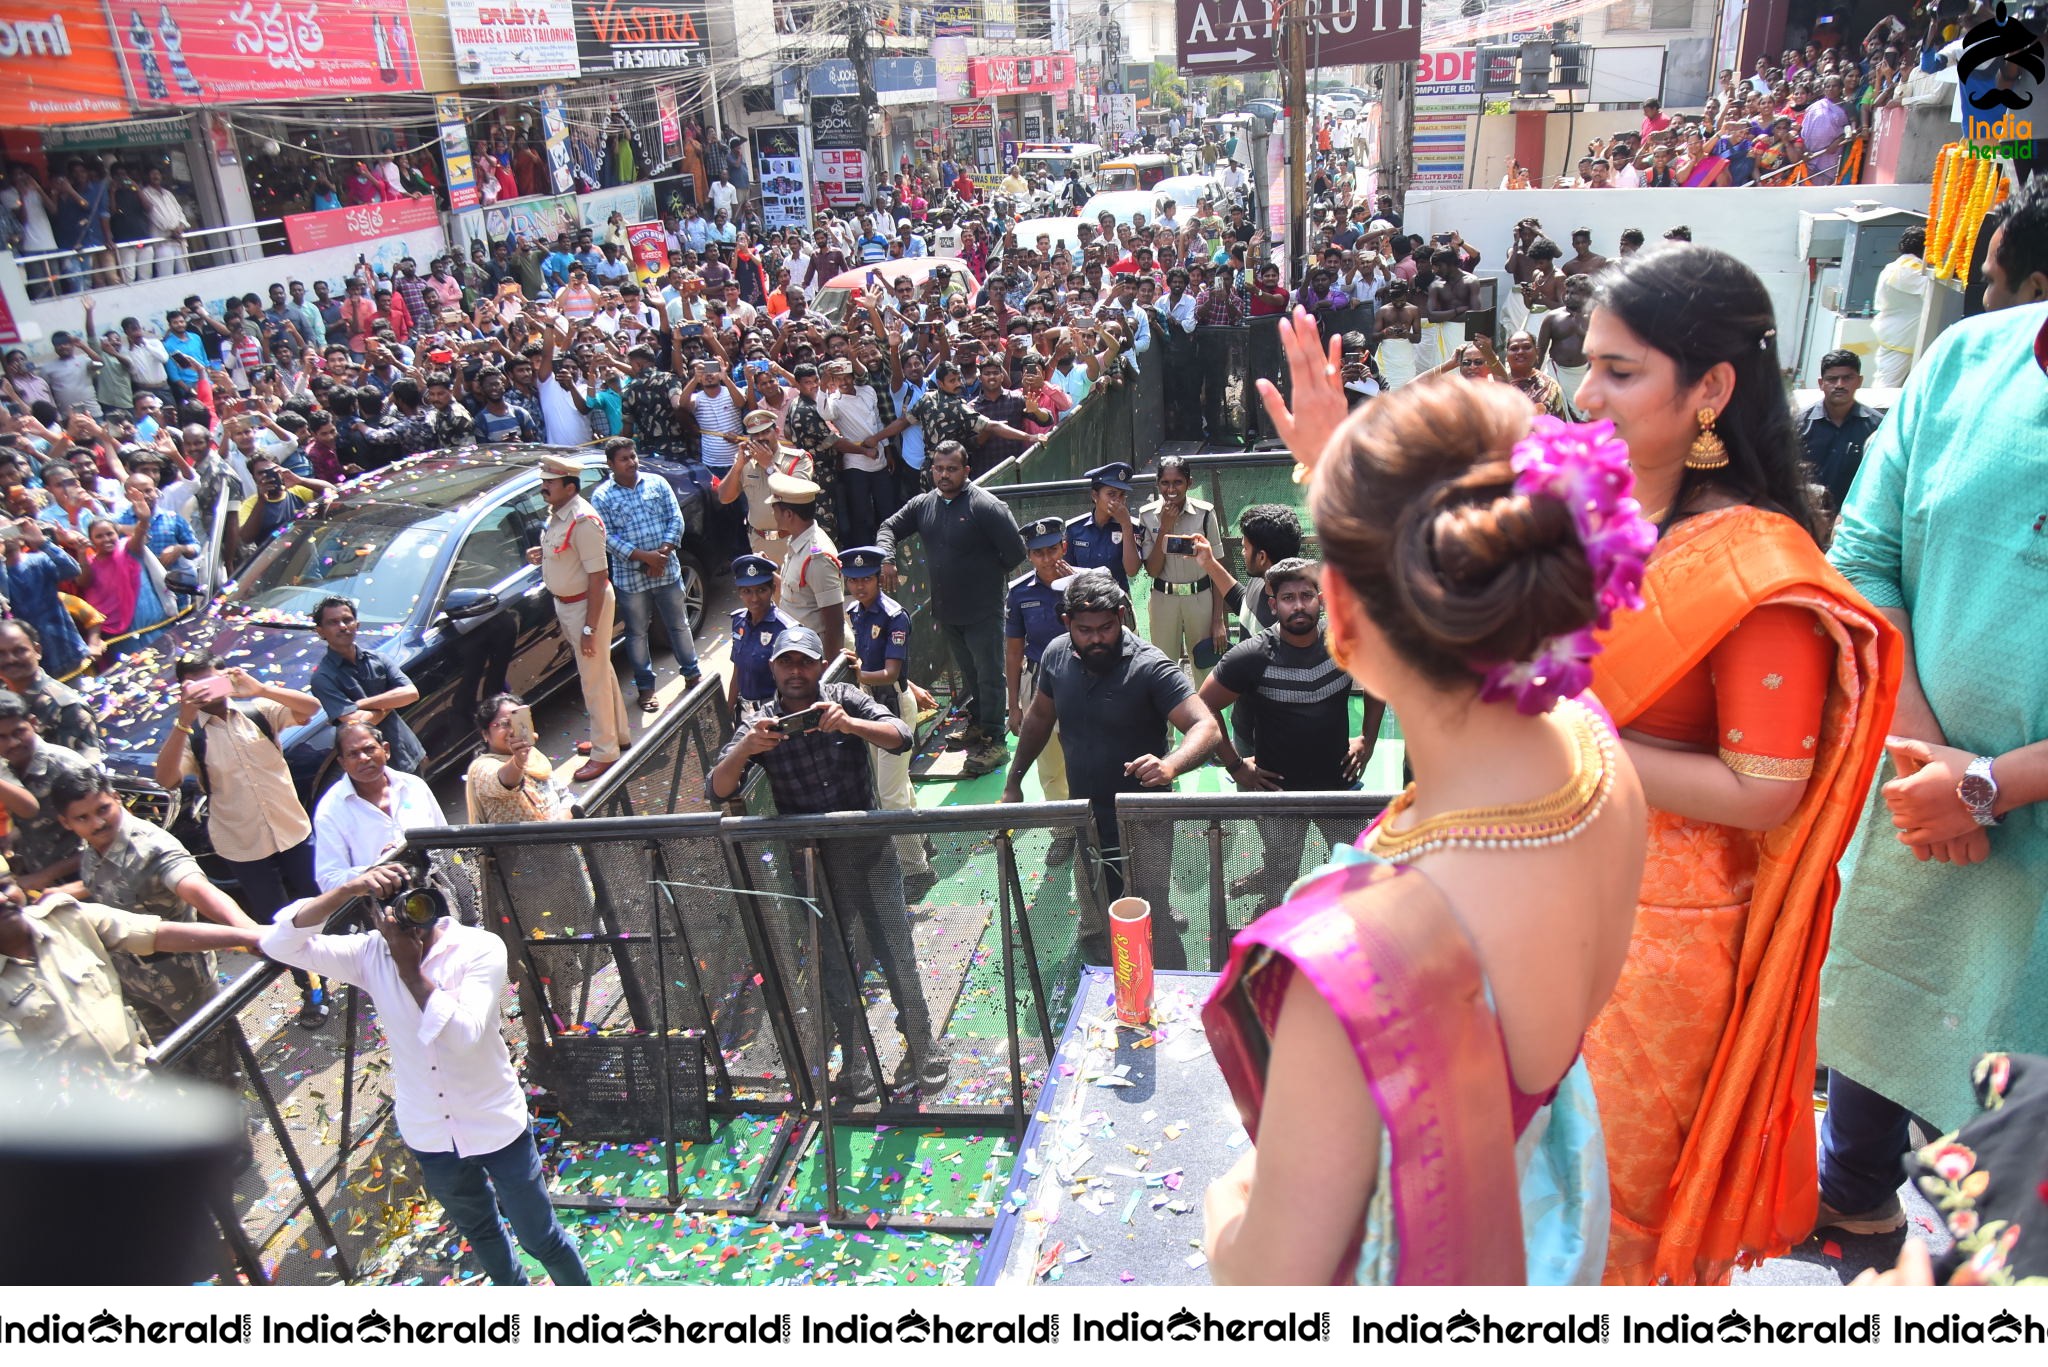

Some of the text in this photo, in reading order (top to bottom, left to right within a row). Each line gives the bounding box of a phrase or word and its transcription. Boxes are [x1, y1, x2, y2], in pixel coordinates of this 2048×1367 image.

[583, 0, 699, 42] VASTRA
[455, 27, 575, 44] TRAVELS & LADIES TAILORING
[613, 49, 690, 69] FASHIONS
[1414, 86, 1456, 95] OMPUTER
[29, 98, 83, 113] Preferred
[817, 119, 853, 128] JOCK
[968, 175, 989, 183] ISWAS
[1114, 932, 1138, 990] Angel's
